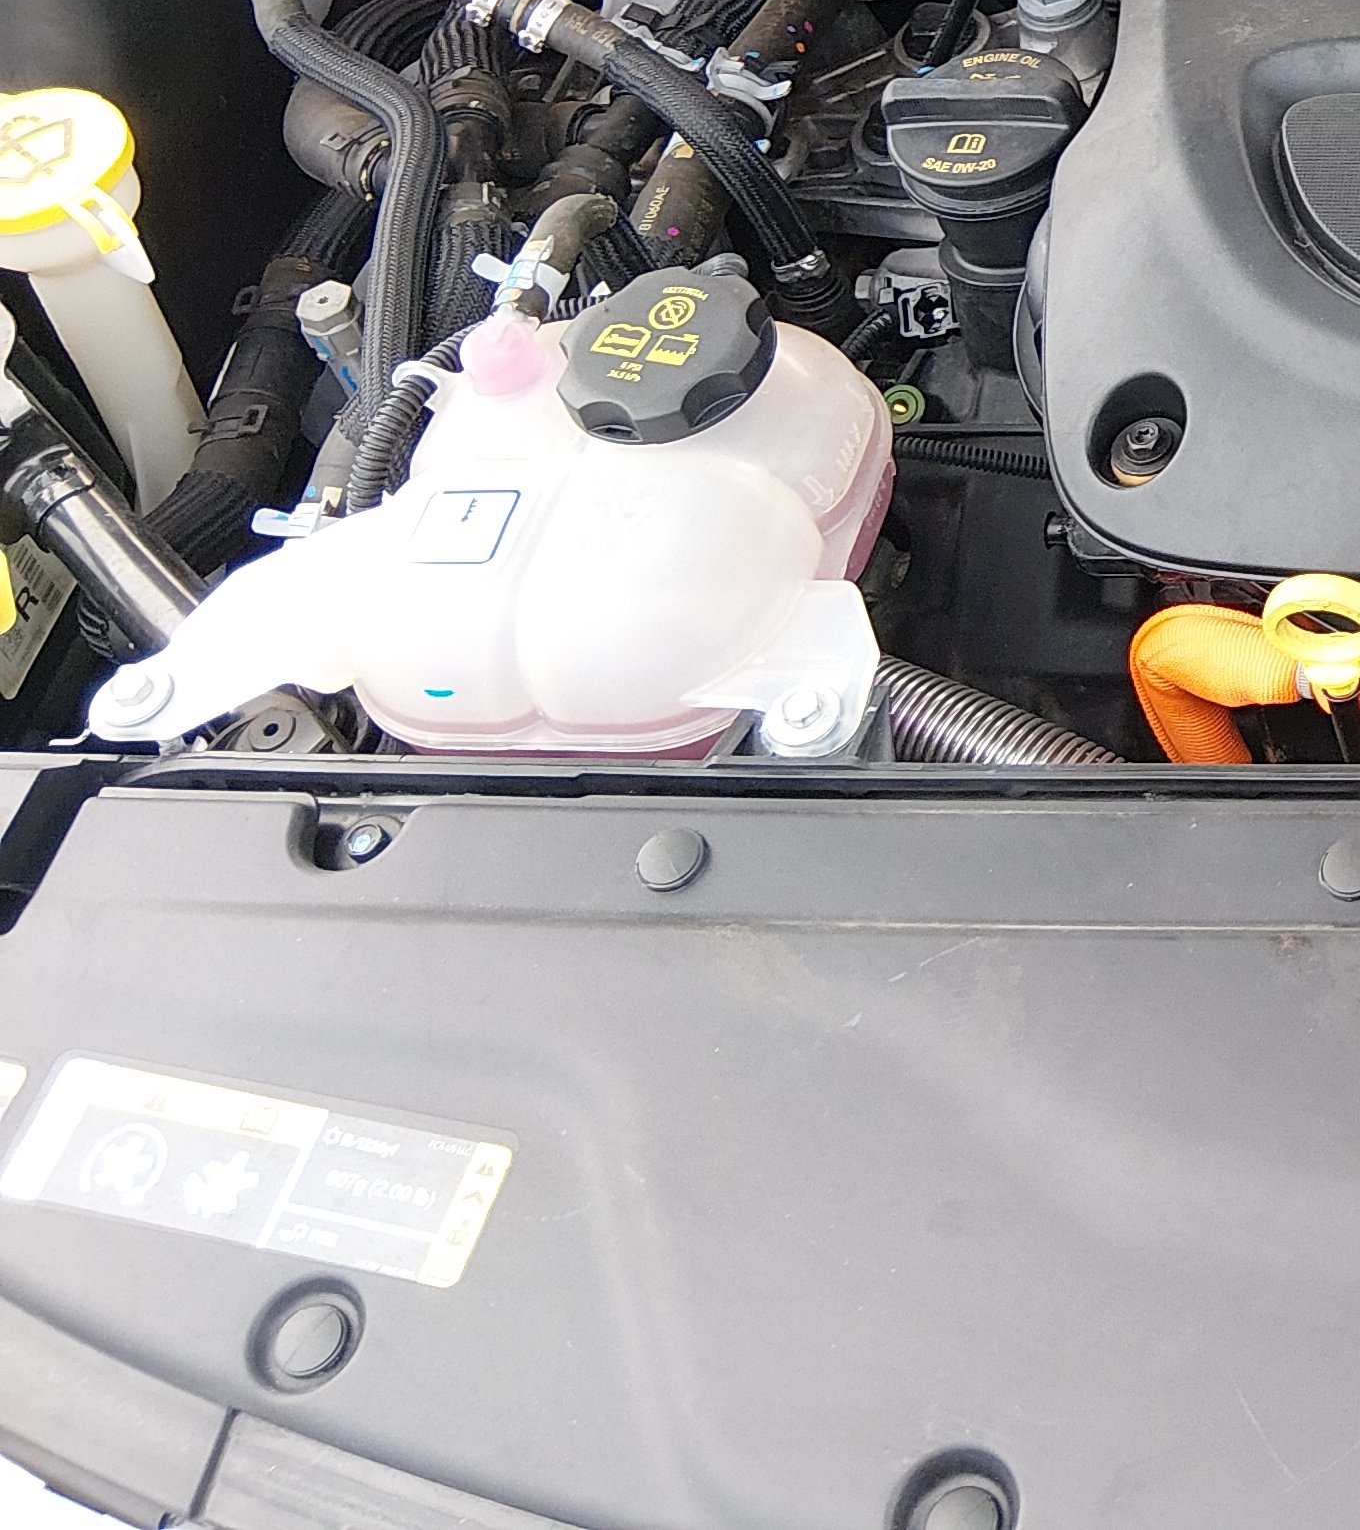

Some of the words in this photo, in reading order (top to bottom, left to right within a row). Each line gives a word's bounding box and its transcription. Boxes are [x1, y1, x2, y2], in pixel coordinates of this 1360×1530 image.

[962, 53, 1019, 68] ENGINE
[1020, 54, 1042, 69] OIL
[922, 157, 952, 173] SAE
[952, 158, 998, 174] 0W-20
[15, 585, 40, 623] R
